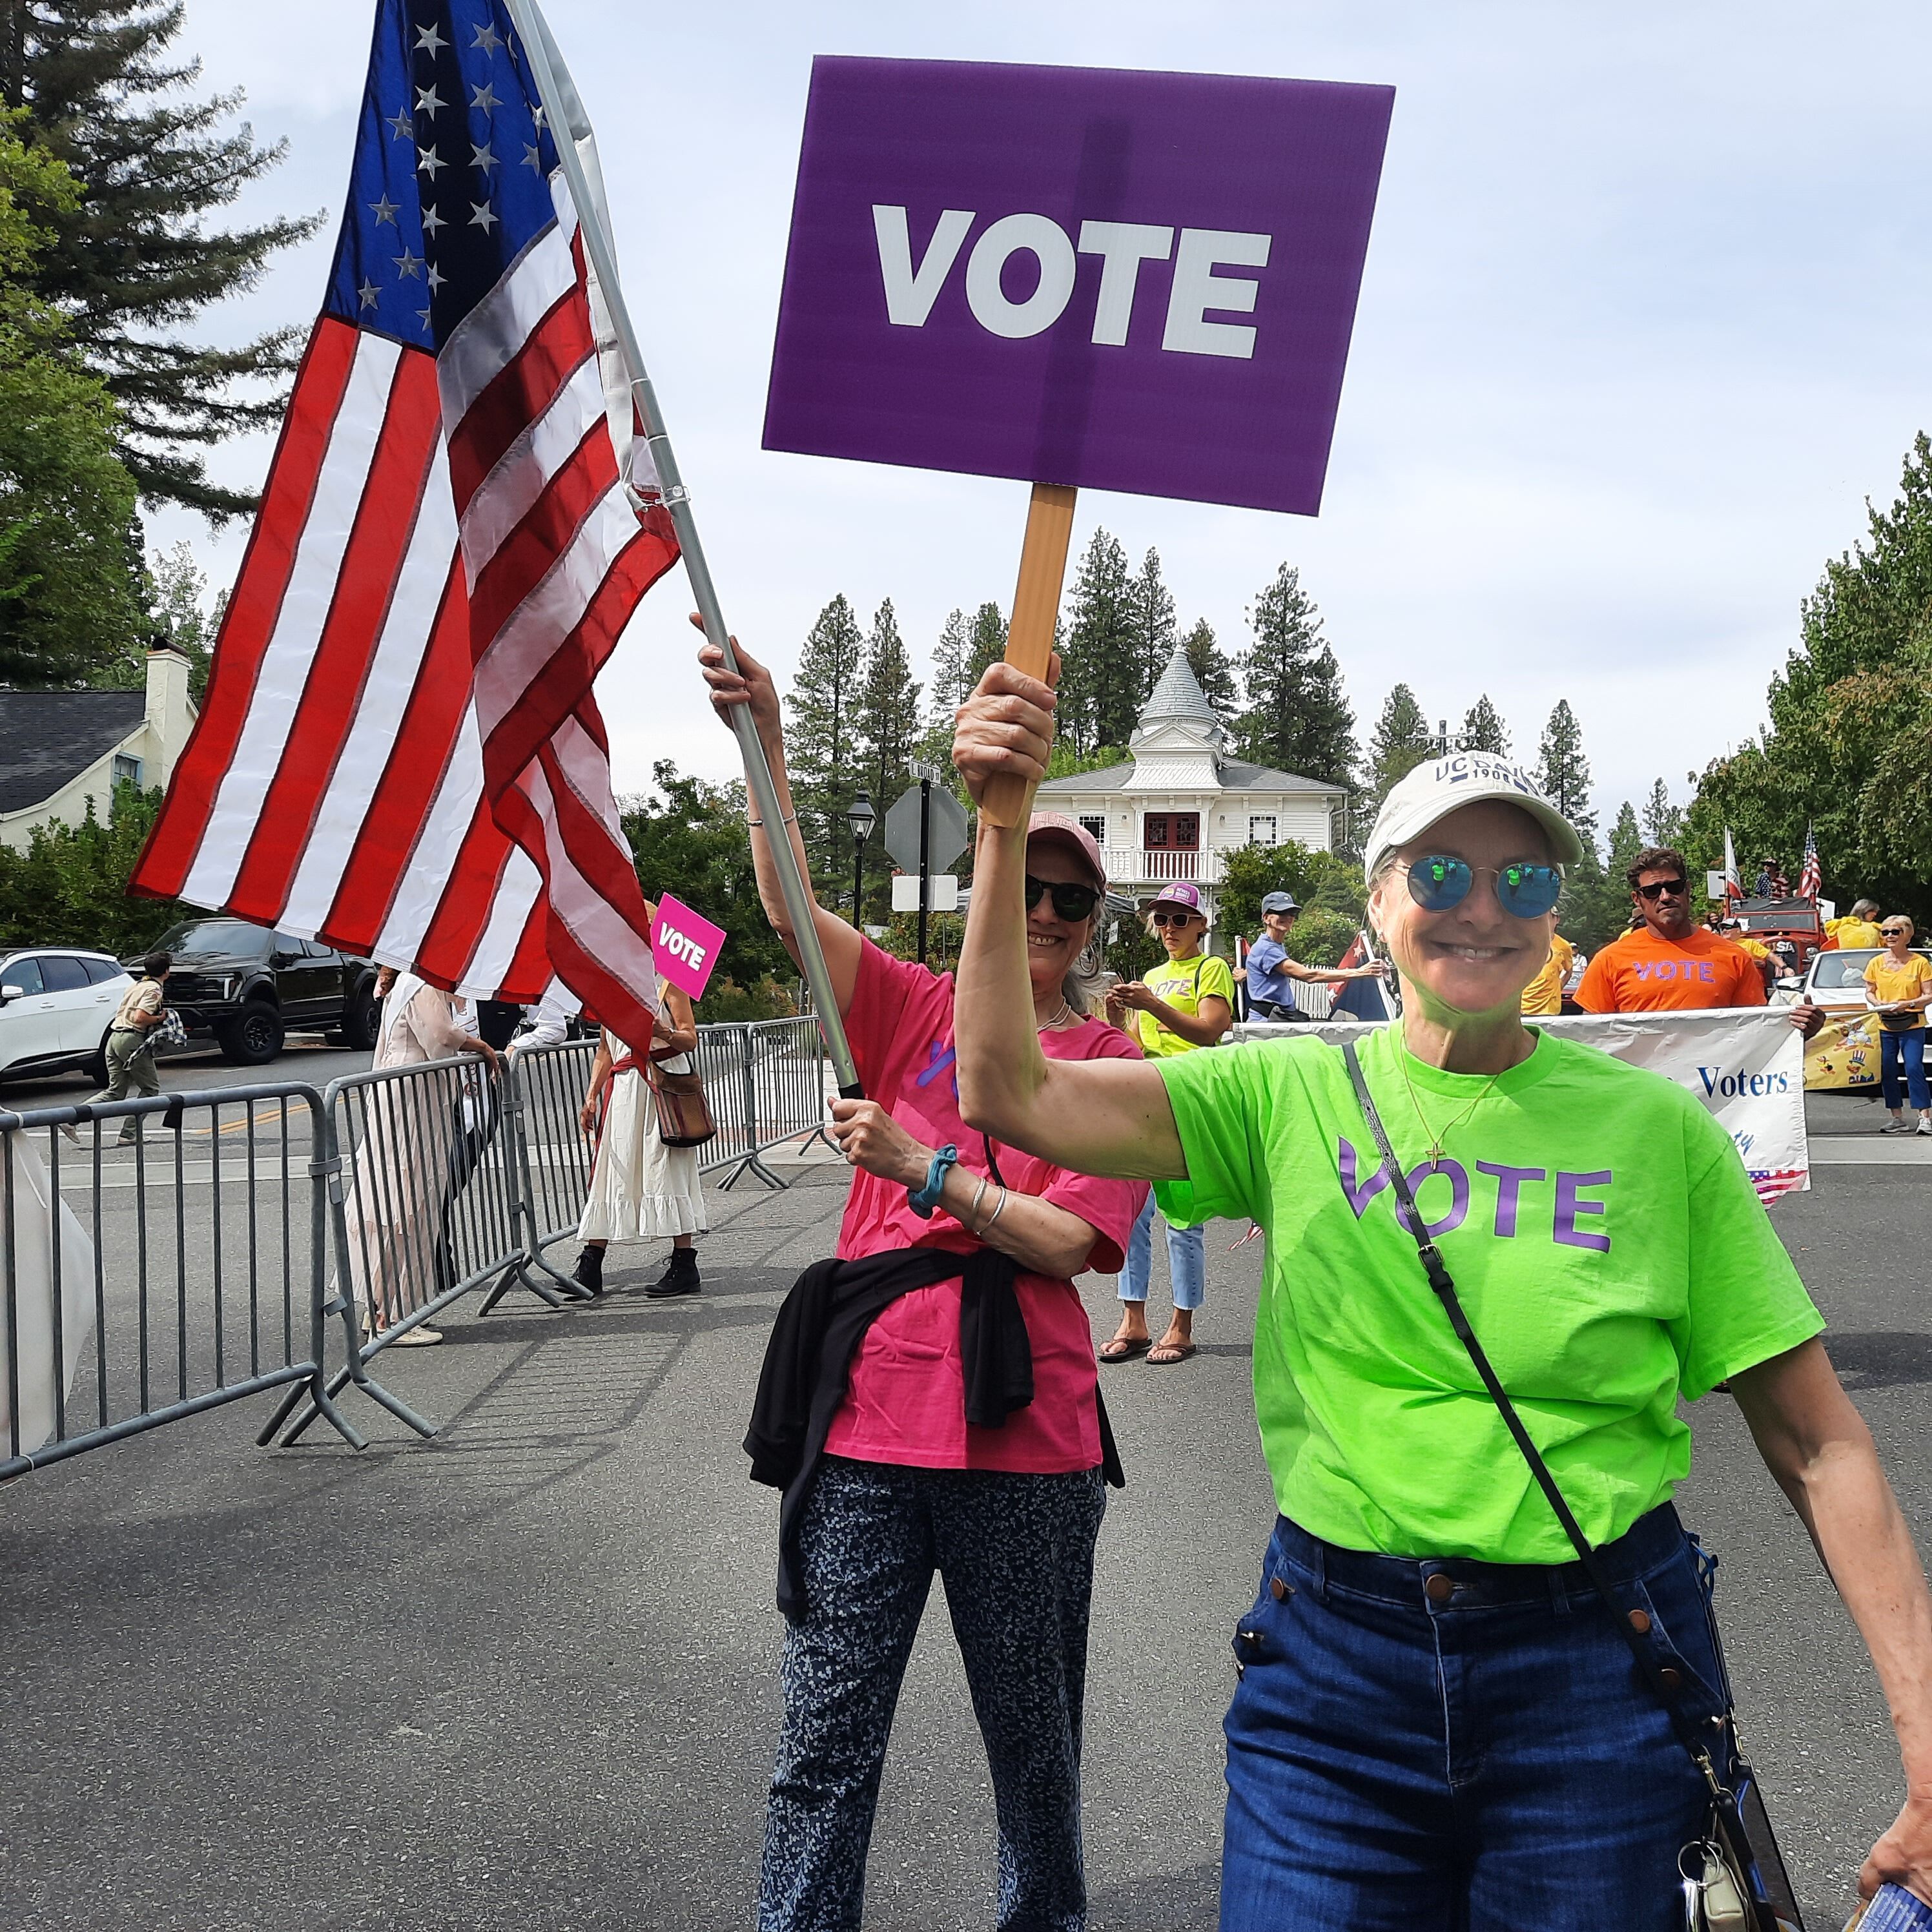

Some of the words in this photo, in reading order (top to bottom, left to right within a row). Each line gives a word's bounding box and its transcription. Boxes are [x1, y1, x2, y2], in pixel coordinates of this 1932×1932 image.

[872, 204, 1272, 360] VOTE
[918, 765, 934, 781] BROAD
[1435, 757, 1468, 782] UC
[658, 921, 707, 972] VOTE
[1632, 961, 1716, 983] VOTE
[1696, 1067, 1788, 1098] Voters
[1337, 1135, 1612, 1254] VOTE
